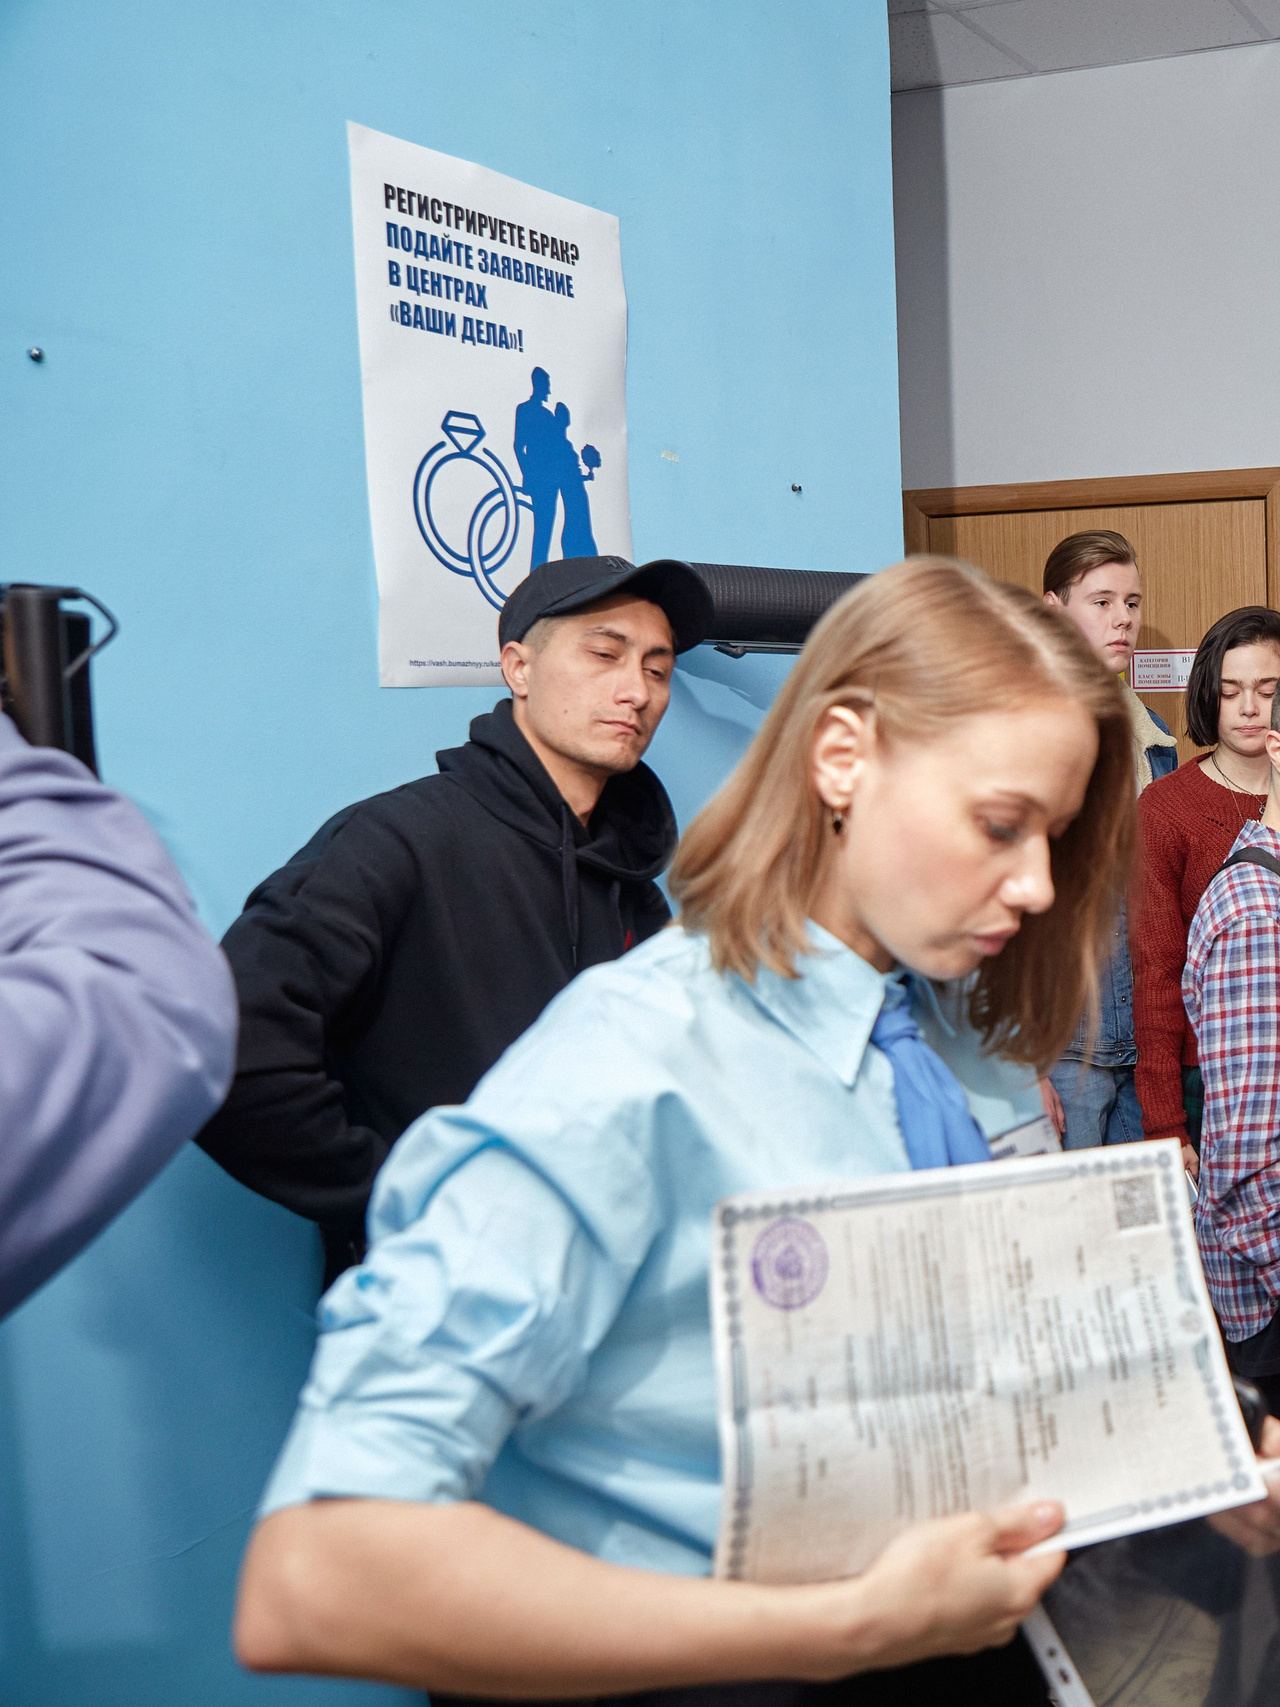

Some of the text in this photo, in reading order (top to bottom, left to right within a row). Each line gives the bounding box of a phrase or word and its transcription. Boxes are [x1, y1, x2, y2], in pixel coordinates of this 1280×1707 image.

[384, 183, 580, 266] РЕГИСТРИРУЕТЕ БРАК?
[386, 221, 575, 298] ПОДАЙТЕ ЗАЯВЛЕНИЕ
[388, 260, 488, 309] В ЦЕНТРАХ
[390, 300, 524, 353] «ВАШИ ДЕЛА»!
